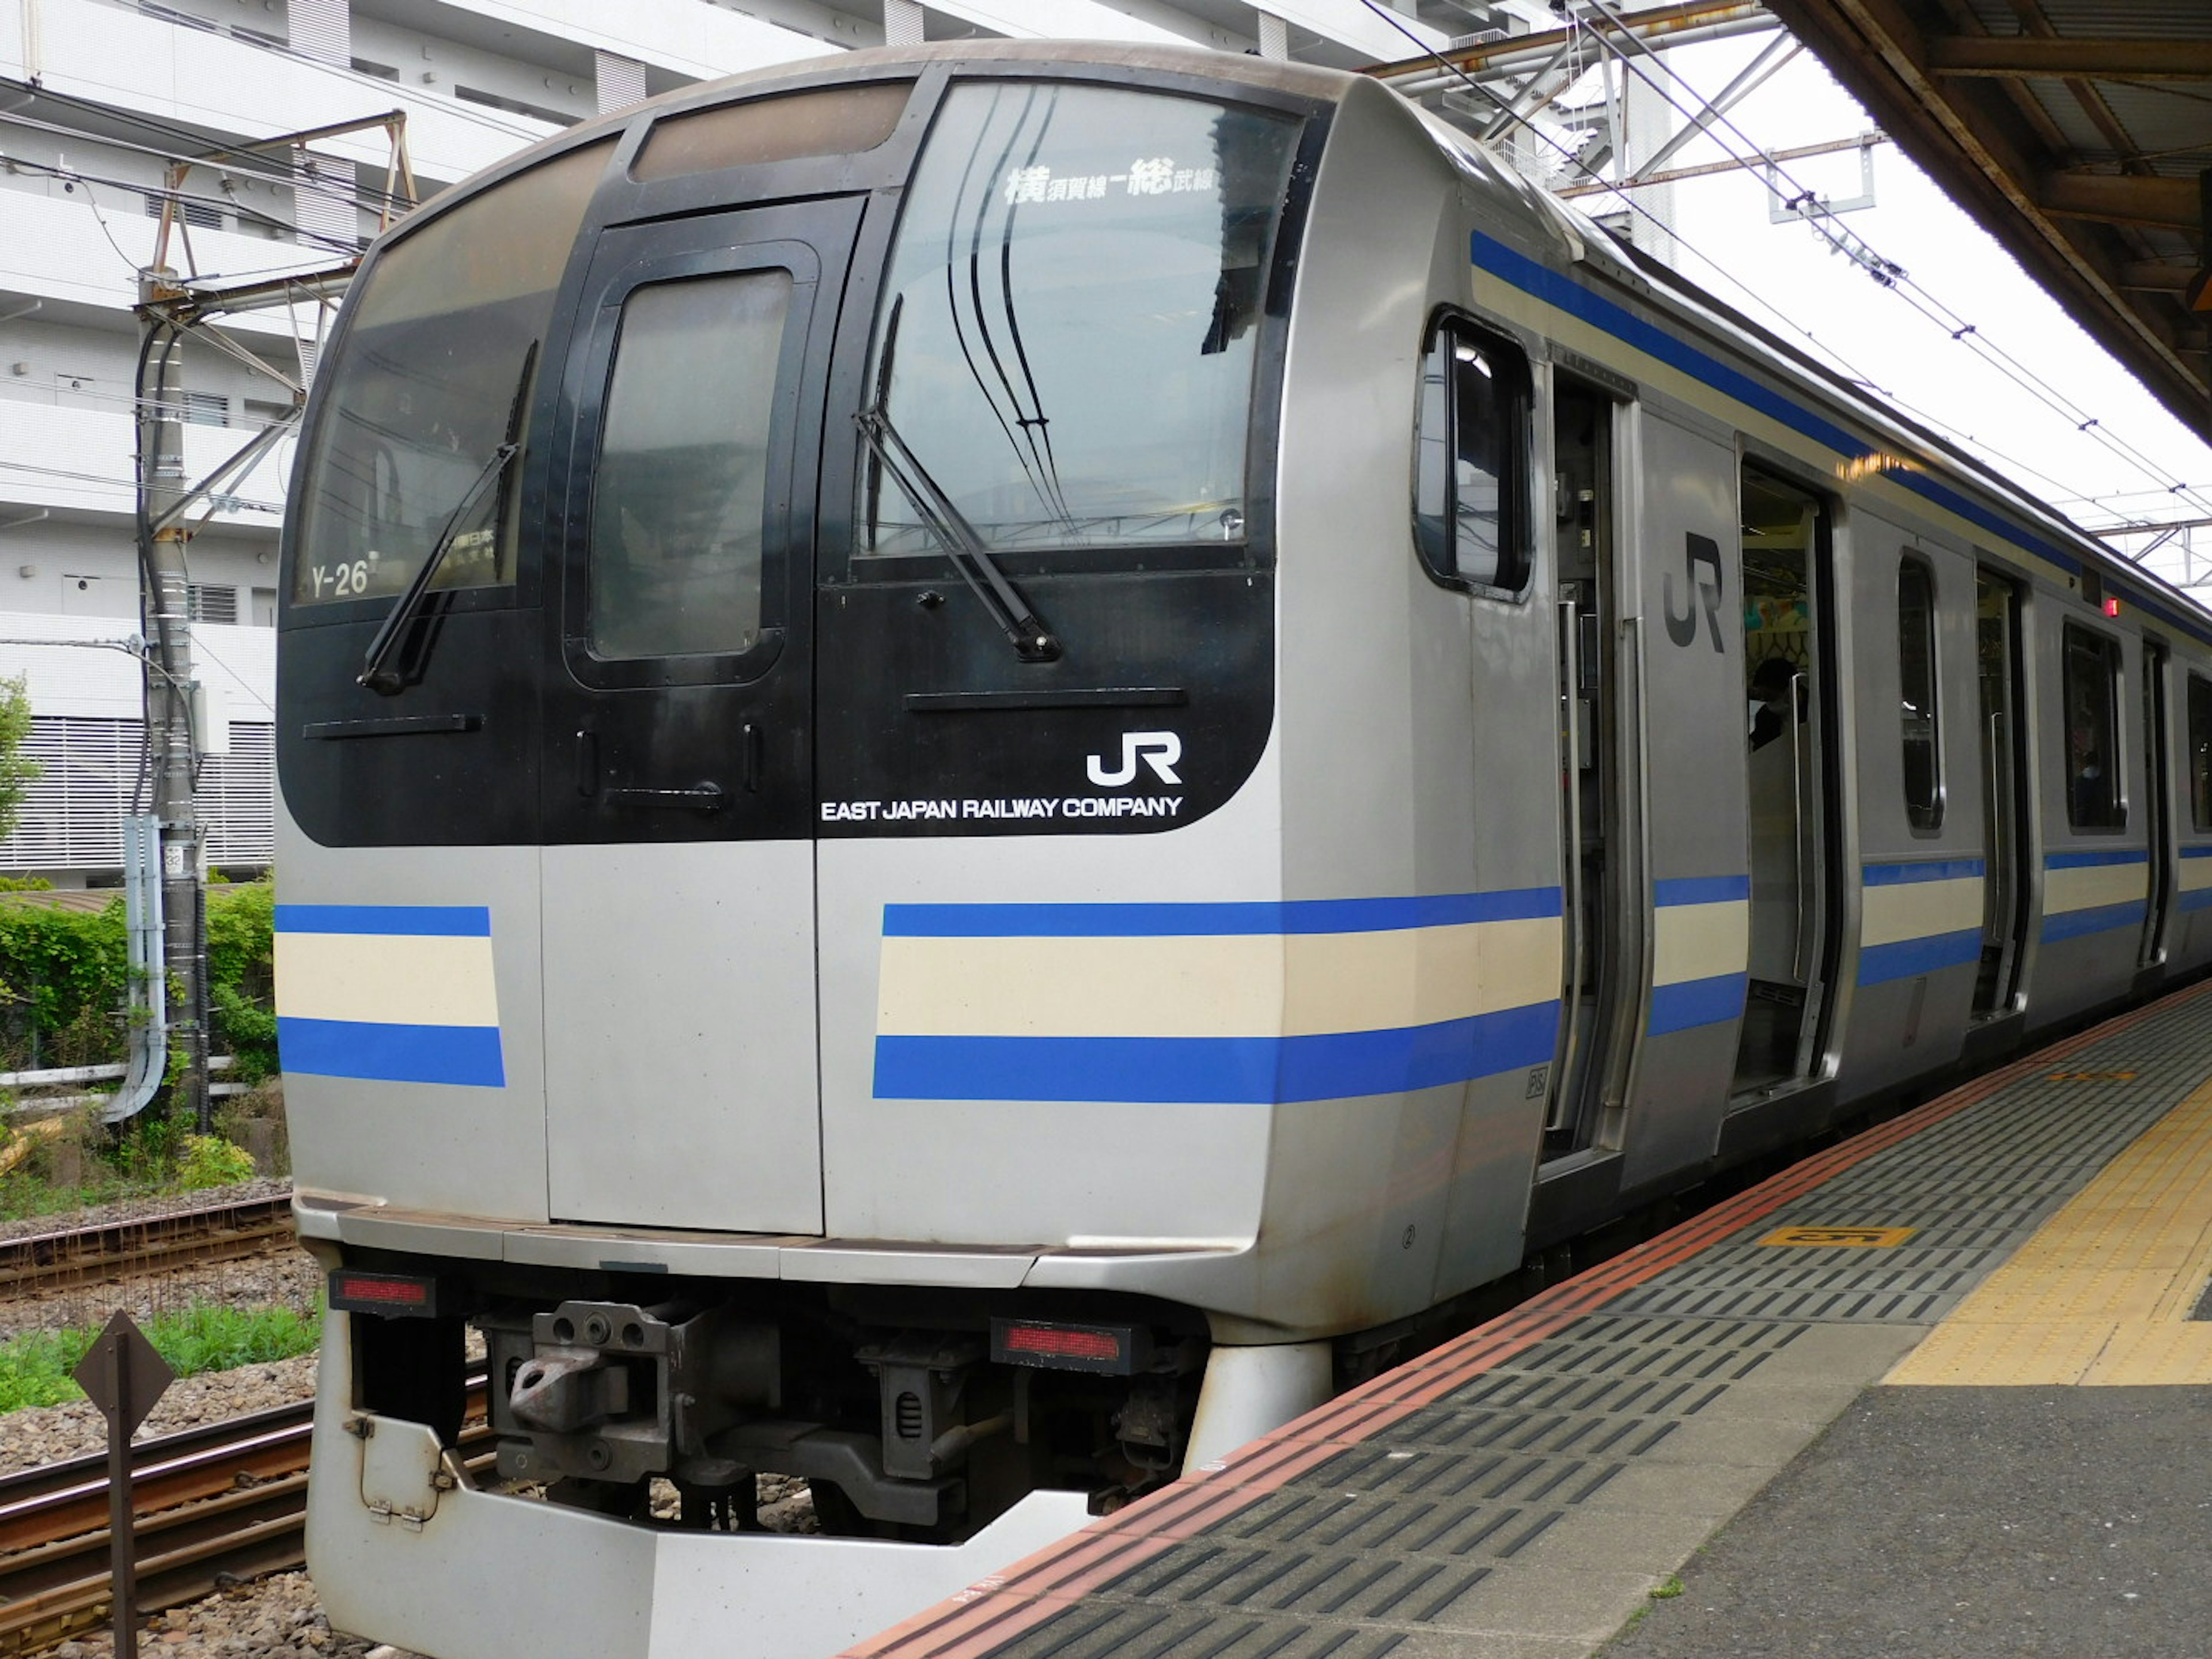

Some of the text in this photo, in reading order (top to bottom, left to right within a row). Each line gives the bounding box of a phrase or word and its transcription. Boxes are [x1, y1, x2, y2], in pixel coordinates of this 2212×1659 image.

[313, 560, 368, 598] Y-26
[1663, 531, 1725, 653] JR
[1087, 730, 1183, 786] JR
[821, 797, 1183, 821] EAST JAPAN RAILWAY COMPANY
